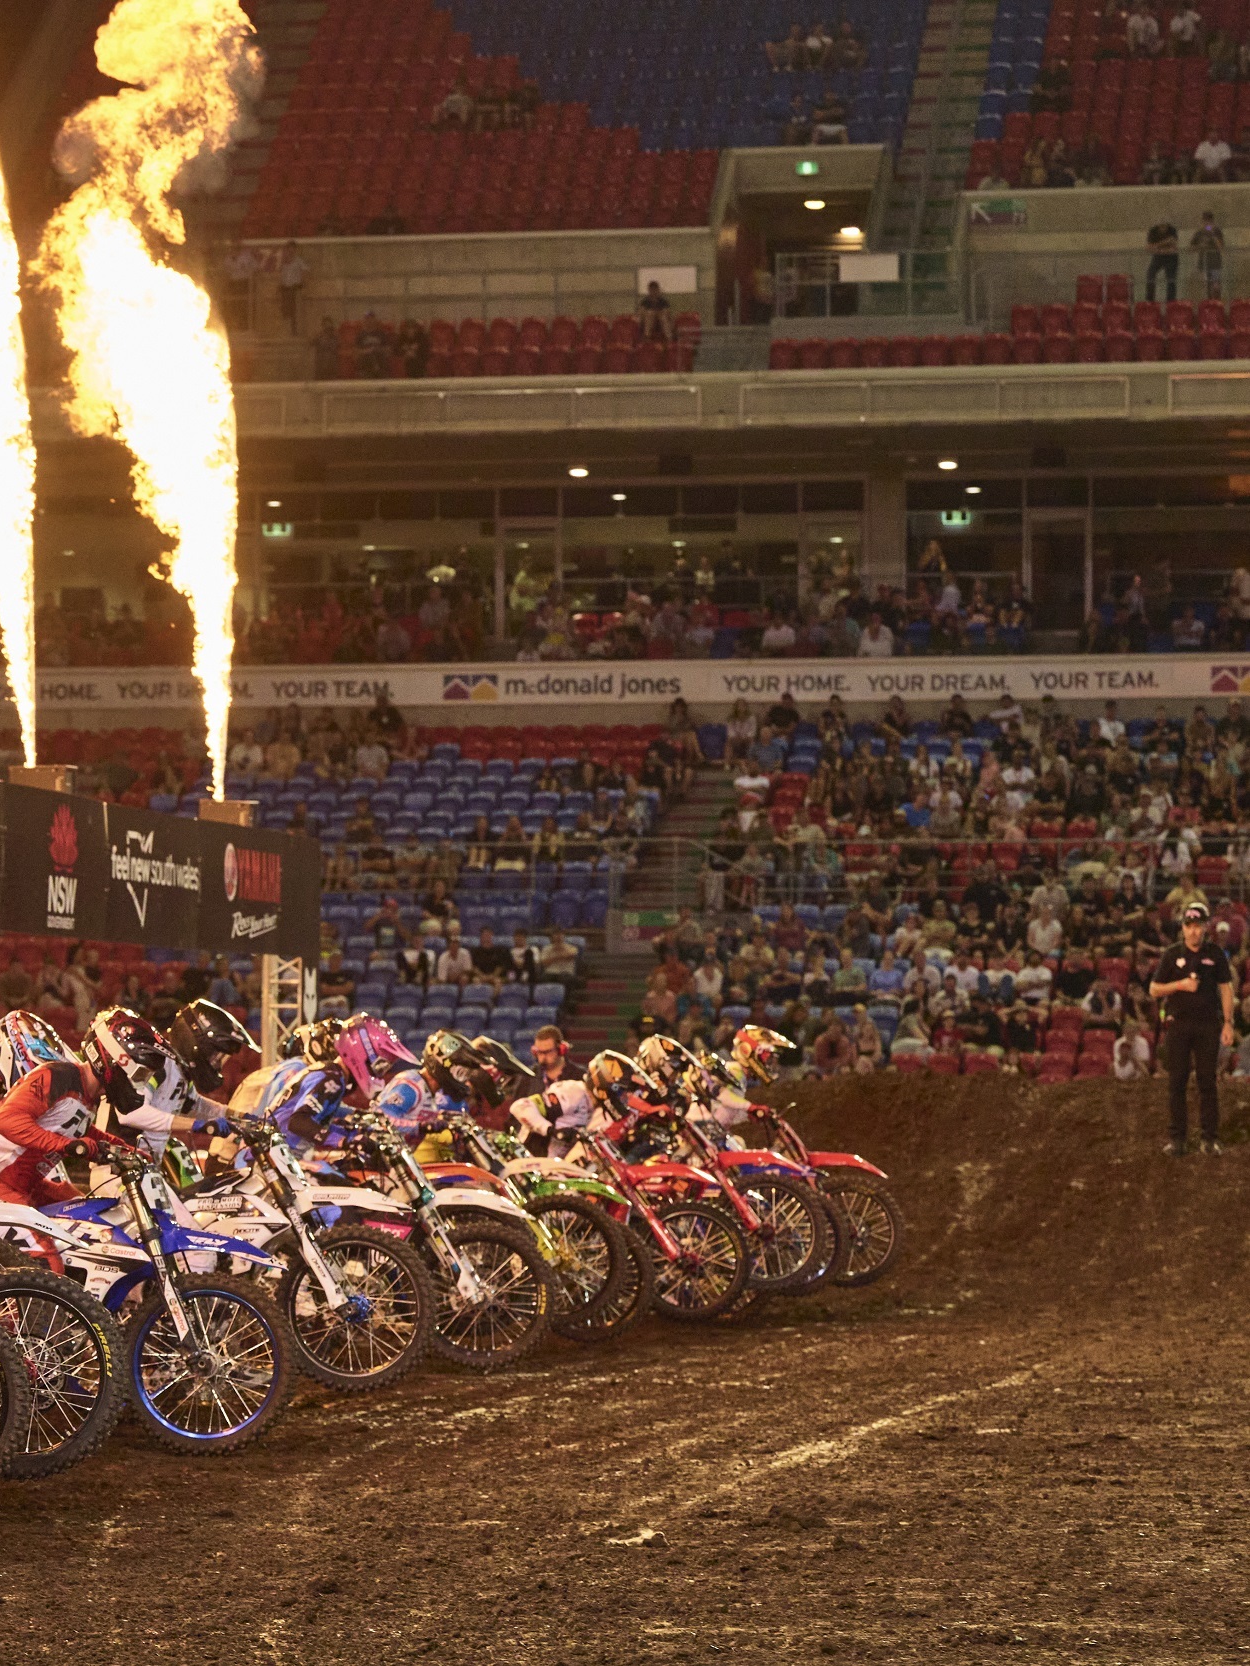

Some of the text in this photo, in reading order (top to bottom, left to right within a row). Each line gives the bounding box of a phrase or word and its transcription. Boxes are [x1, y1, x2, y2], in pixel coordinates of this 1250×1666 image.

[116, 682, 171, 700] YOUR
[270, 681, 328, 699] YOUR
[332, 681, 395, 699] TEAM.
[617, 673, 681, 699] jones
[722, 674, 780, 693] YOUR
[785, 674, 850, 692] HOME.
[866, 673, 925, 692] YOUR
[930, 672, 1010, 692] DREAM.
[1030, 671, 1089, 690] YOUR
[1094, 670, 1159, 689] TEAM.
[47, 874, 78, 915] NSW
[110, 1248, 137, 1258] Castrol
